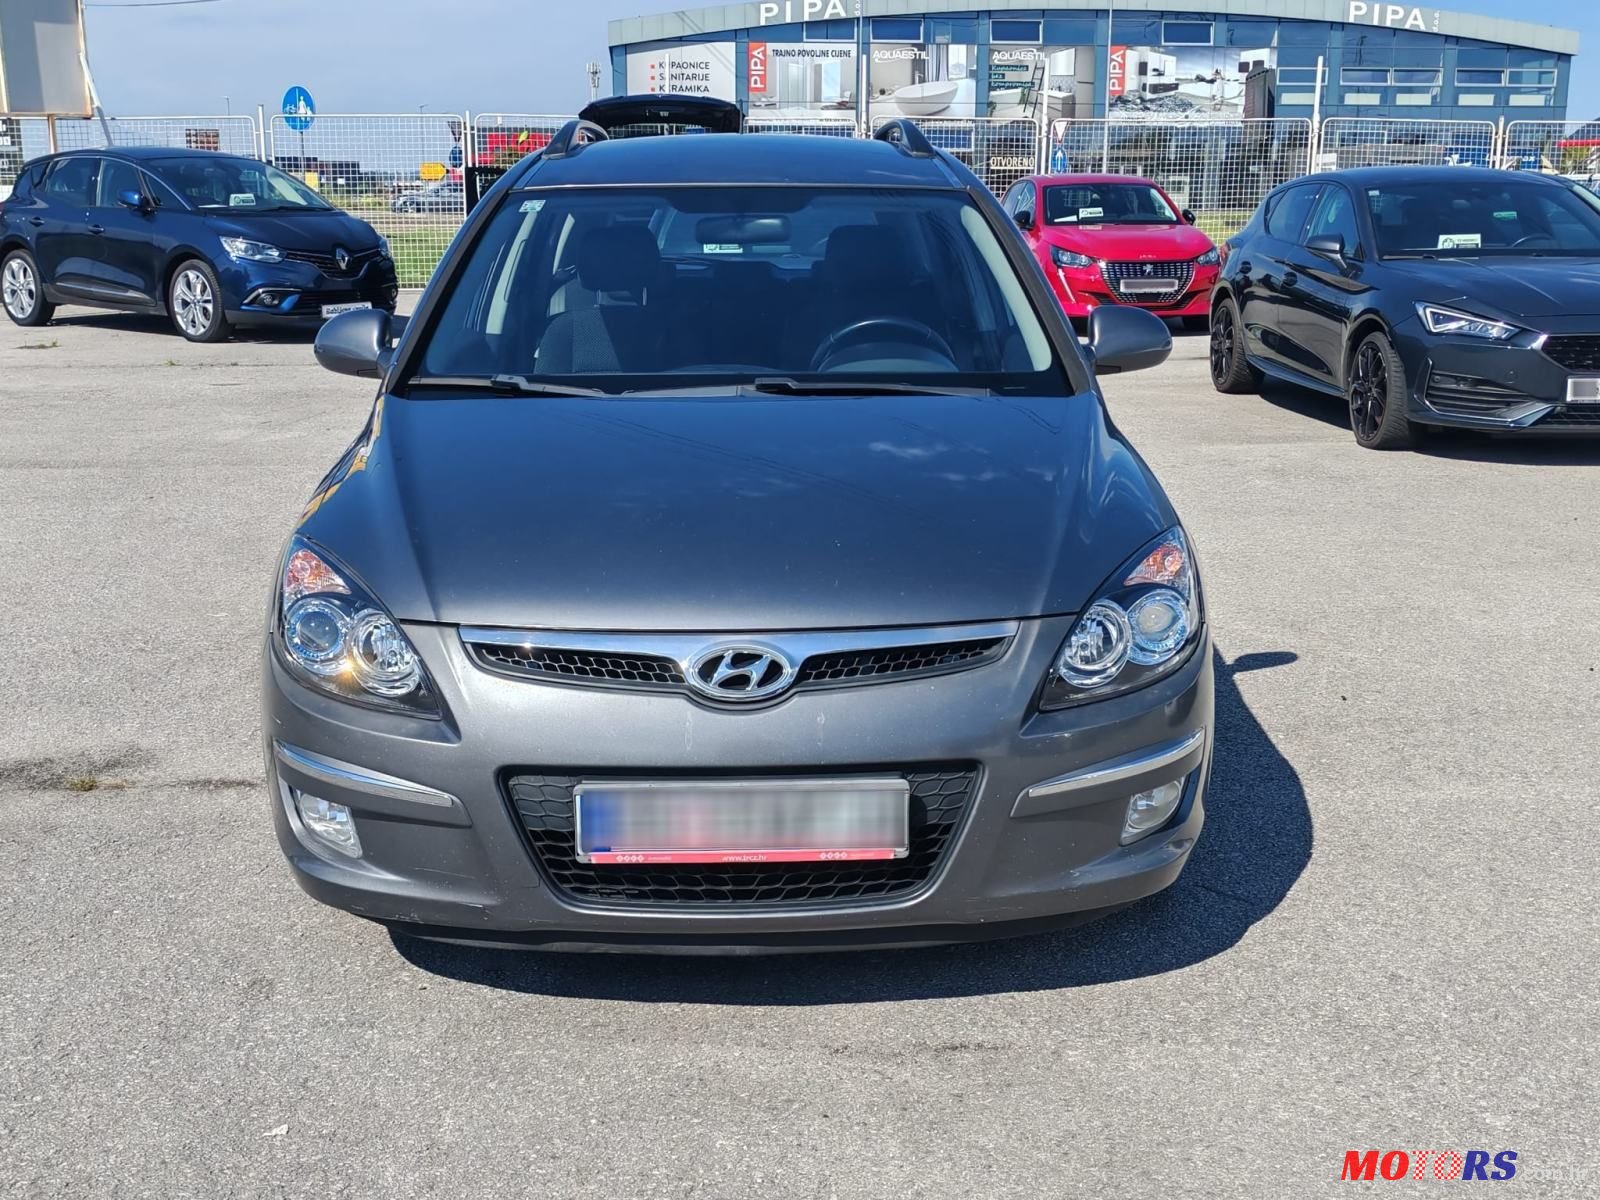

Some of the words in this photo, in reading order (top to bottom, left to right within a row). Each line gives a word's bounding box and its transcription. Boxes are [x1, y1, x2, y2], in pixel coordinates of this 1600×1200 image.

[760, 0, 847, 25] PIPA
[1349, 1, 1426, 31] PIPA
[772, 49, 796, 58] TRAJNO
[797, 49, 830, 58] POVOLJNE
[831, 50, 852, 58] CIJENE
[873, 48, 929, 61] AQUAESTIL
[659, 61, 711, 70] KPAONICE
[751, 46, 765, 88] PIPA
[1110, 50, 1124, 91] PIPA
[659, 73, 711, 81] SNITARIJE
[659, 84, 710, 93] KRAMIKA
[990, 156, 1035, 167] OTVORENO
